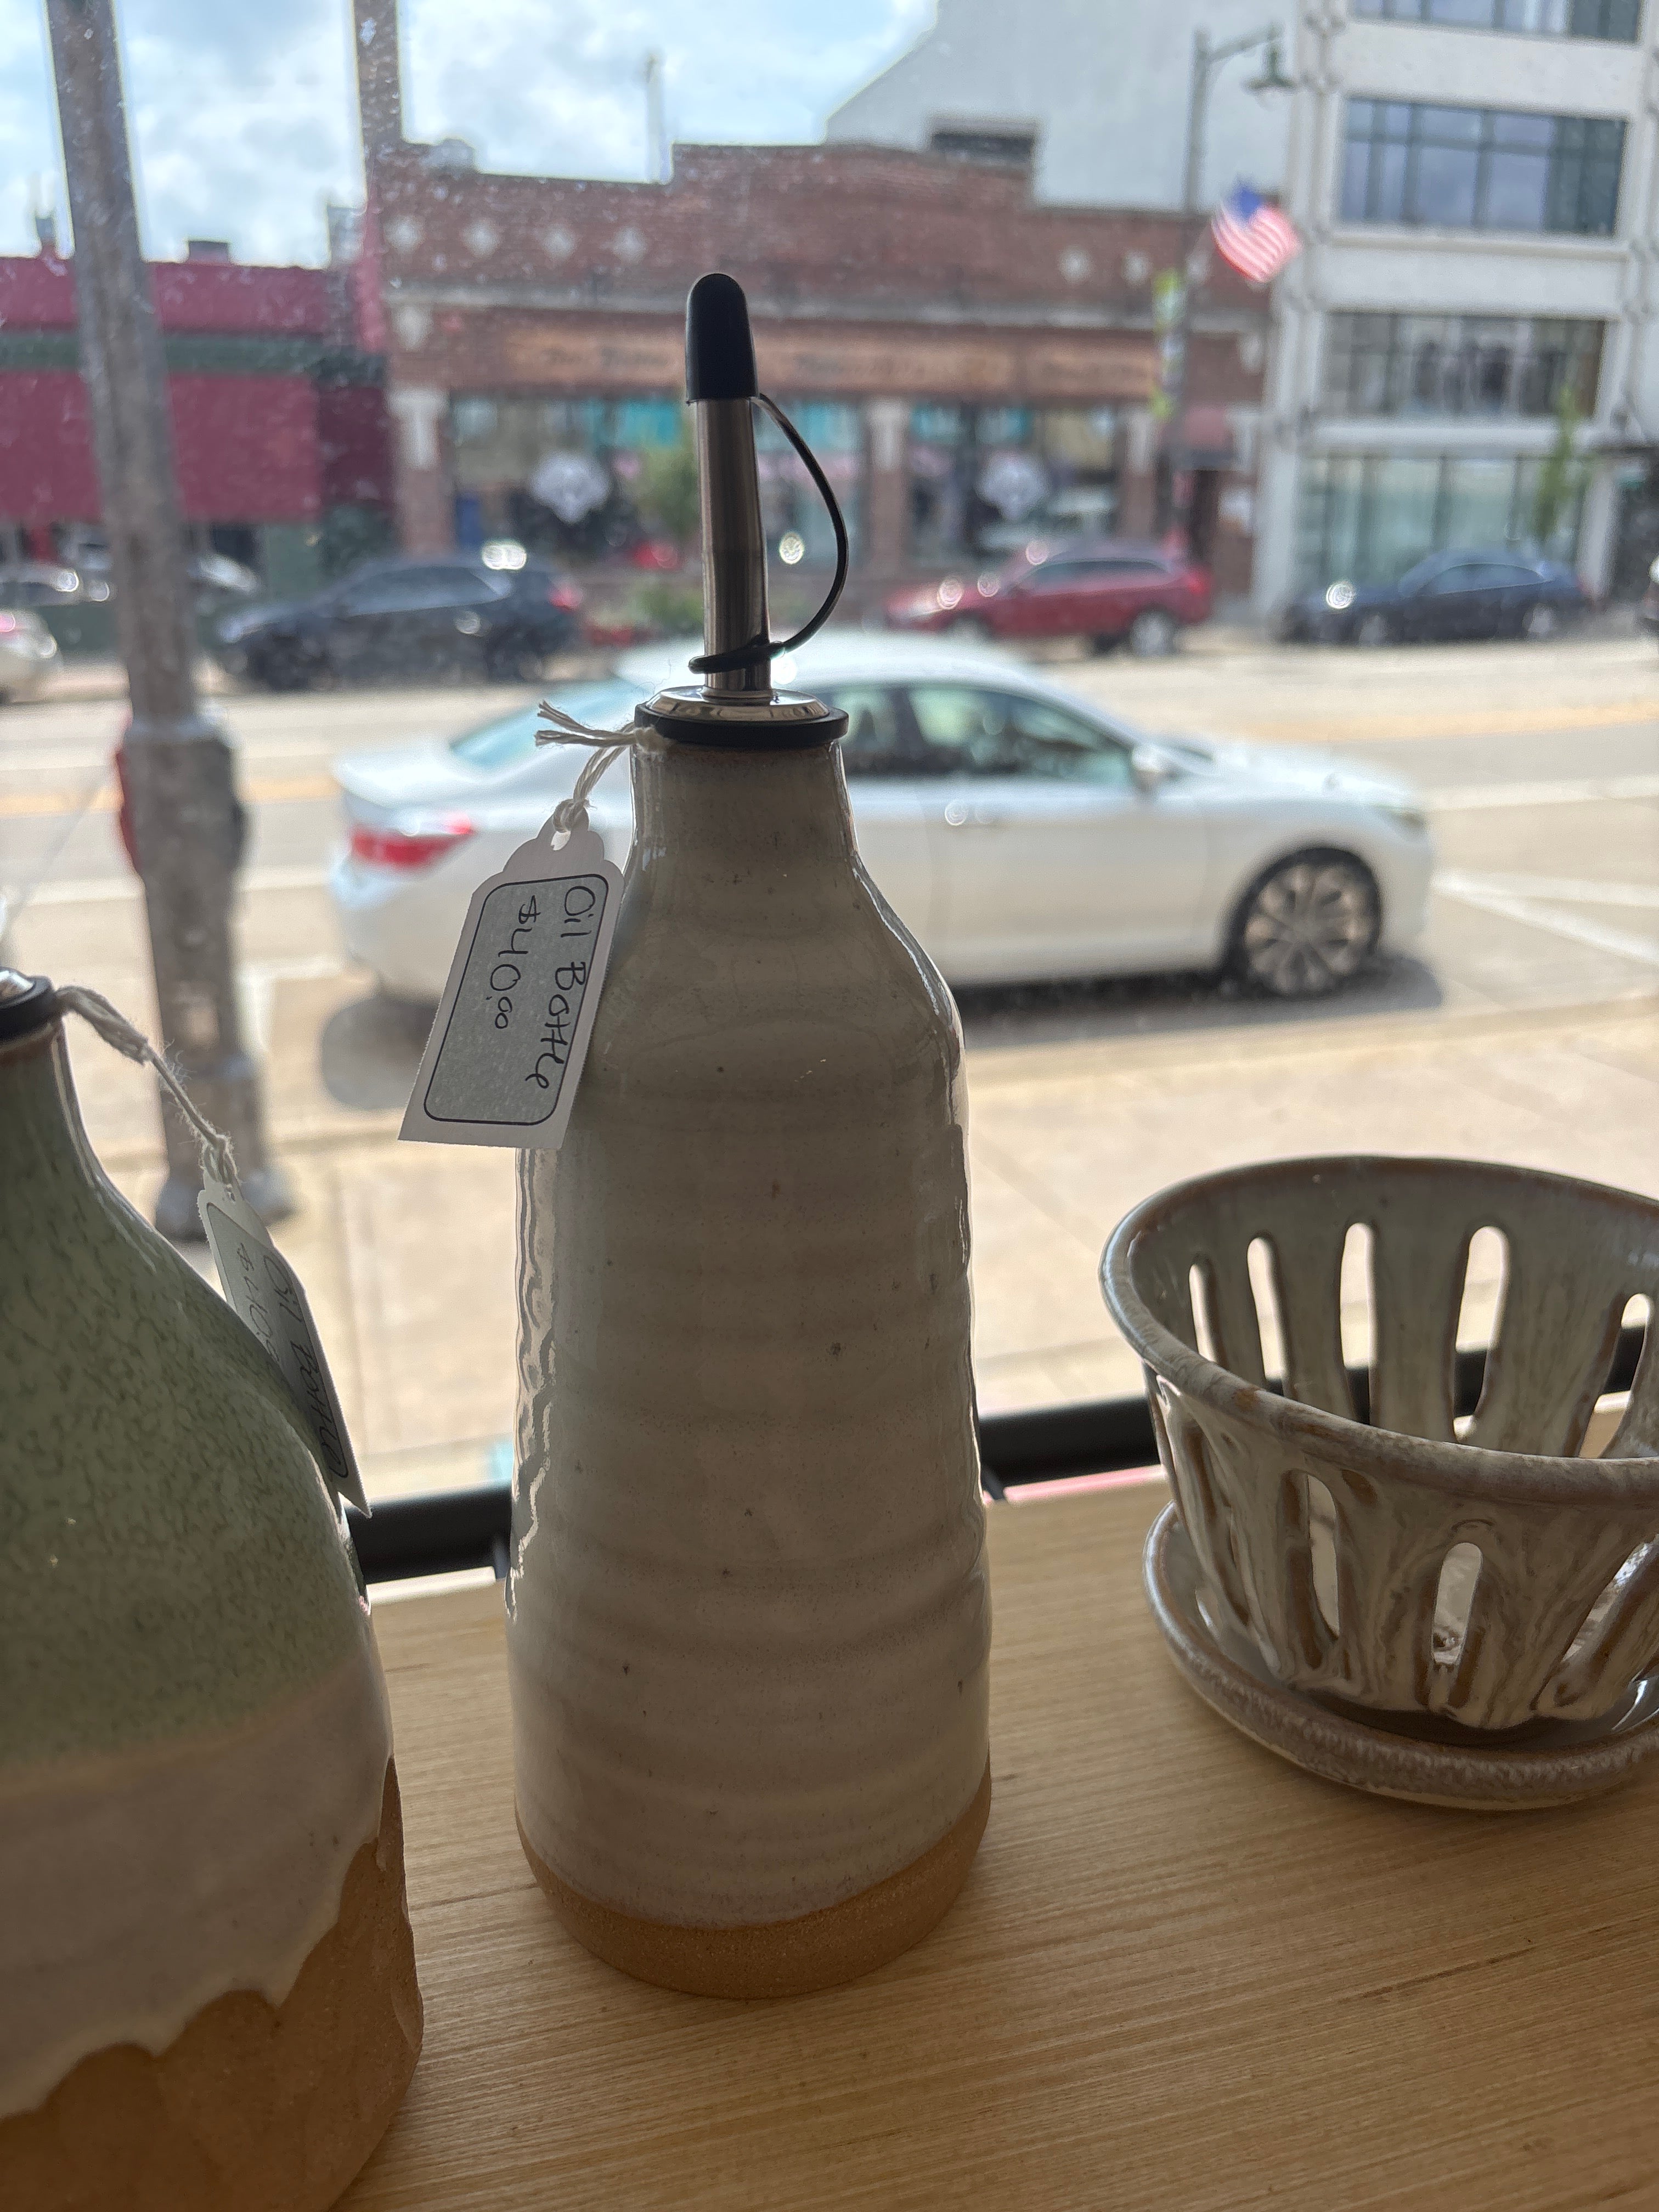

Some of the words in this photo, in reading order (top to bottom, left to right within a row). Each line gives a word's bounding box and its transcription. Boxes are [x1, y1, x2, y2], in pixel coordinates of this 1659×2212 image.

[561, 886, 595, 938] Oil
[525, 961, 586, 1088] Bottle
[264, 1254, 303, 1323] Oil
